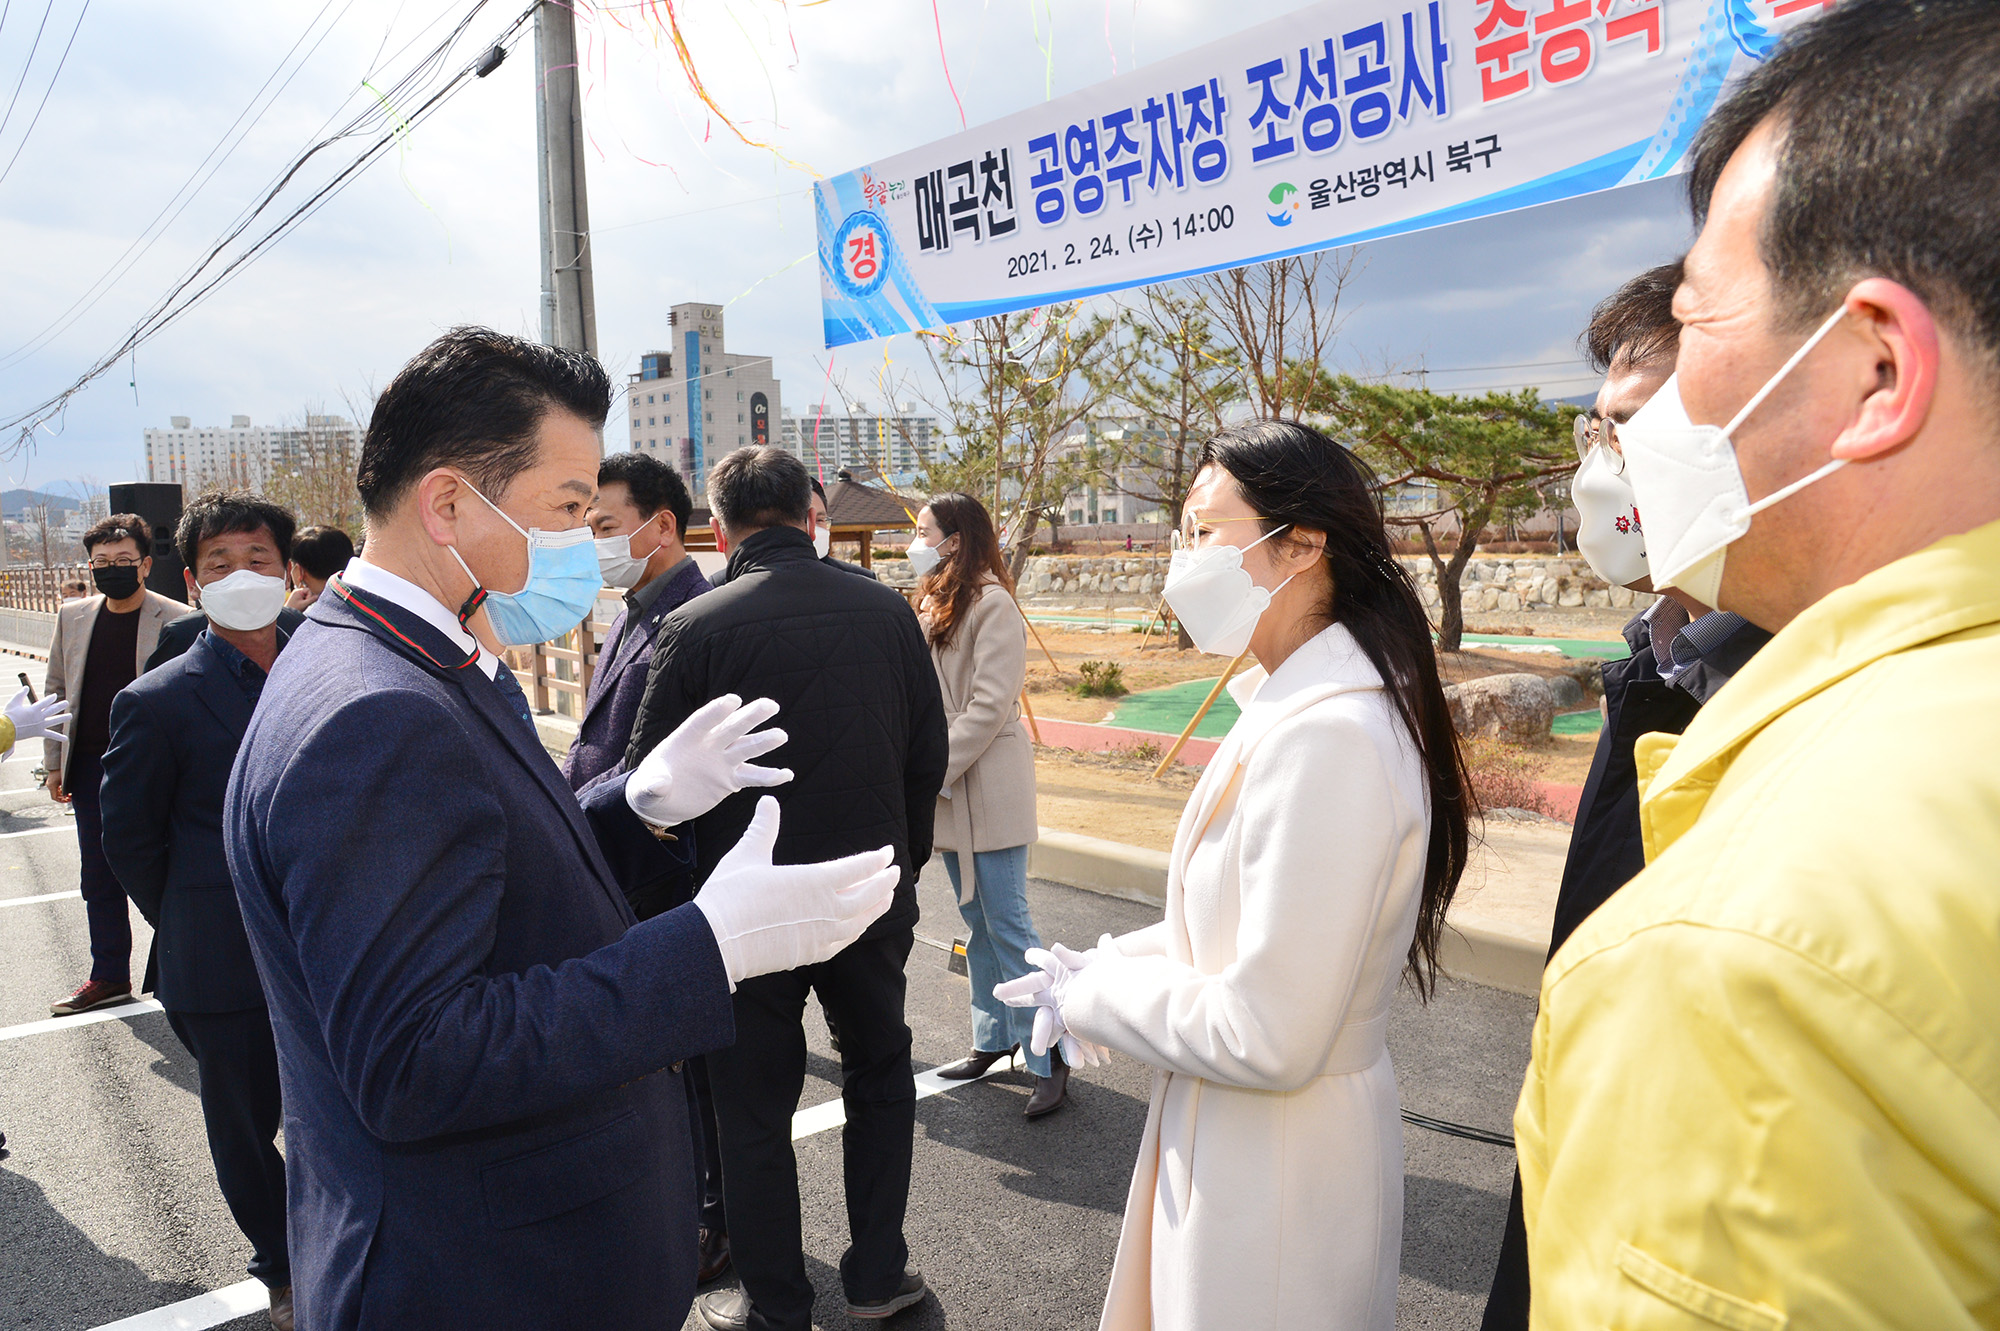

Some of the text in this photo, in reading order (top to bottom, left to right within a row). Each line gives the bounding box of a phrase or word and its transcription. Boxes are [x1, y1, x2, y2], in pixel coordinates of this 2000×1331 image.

[914, 147, 1016, 251] 매곡천
[1028, 77, 1227, 224] 공영주차장
[1246, 0, 1448, 162] 조성공사
[1307, 134, 1502, 210] 울산광역시 북구
[849, 232, 877, 279] 경
[1007, 204, 1234, 279] 2021. 2. 24. (수) 14:00
